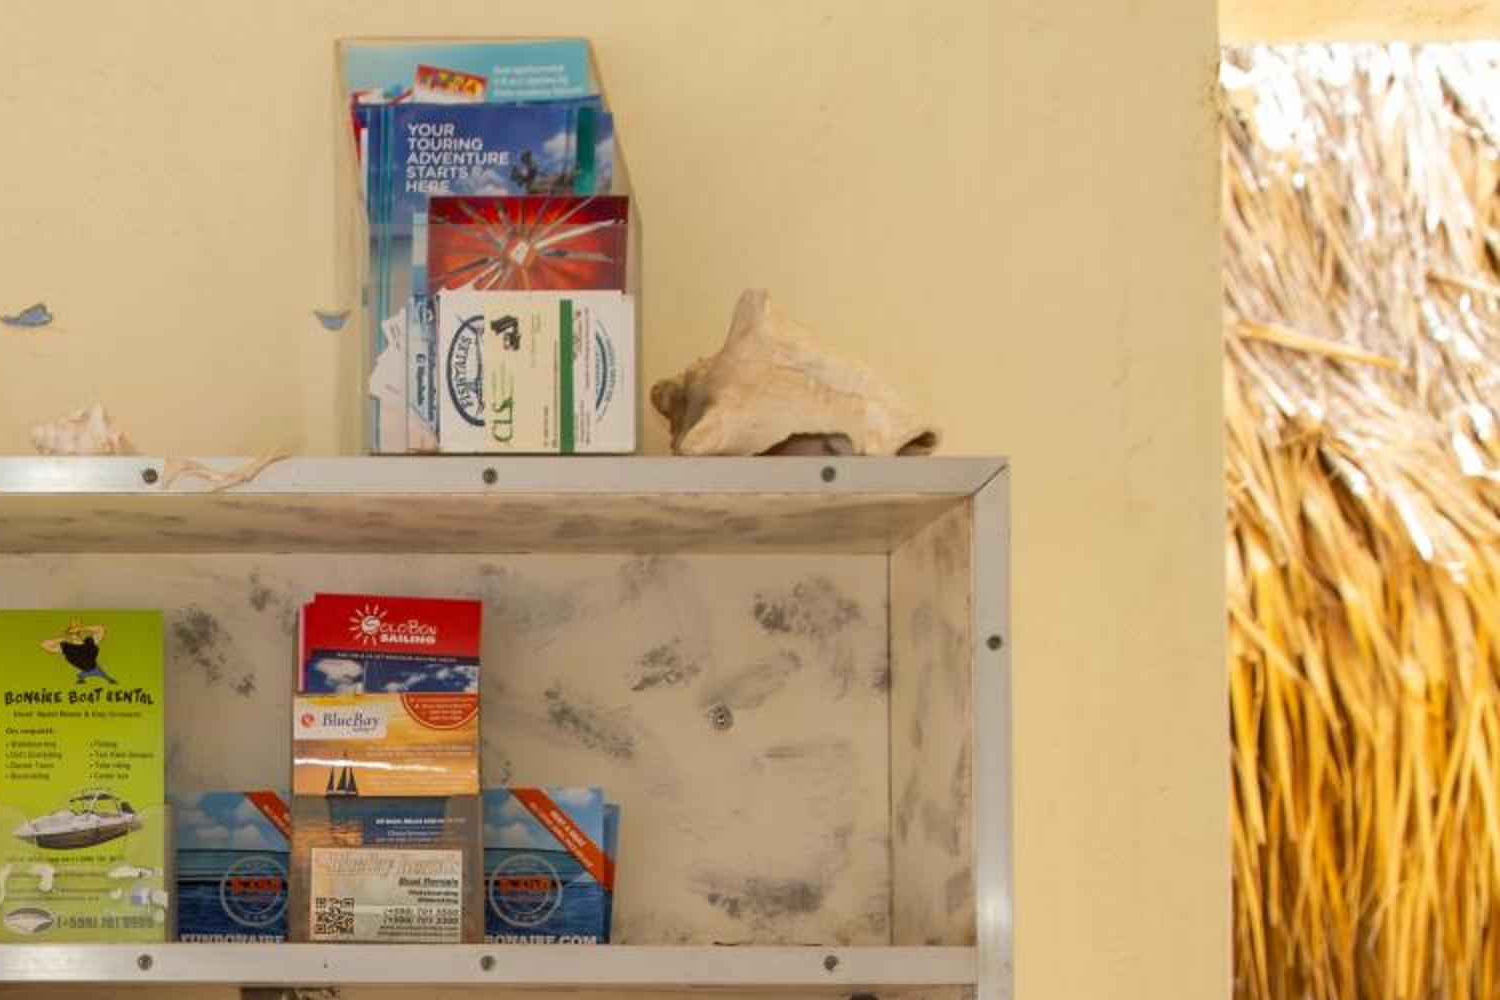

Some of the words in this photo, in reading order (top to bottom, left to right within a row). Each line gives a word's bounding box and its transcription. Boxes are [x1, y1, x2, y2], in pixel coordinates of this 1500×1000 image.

[407, 123, 455, 138] YOUR
[407, 137, 483, 151] TOURING
[406, 151, 510, 165] ADVENTURE
[406, 165, 470, 179] STARTS
[406, 179, 450, 193] HERE
[455, 334, 475, 409] FISHTALES
[380, 635, 437, 645] SAILING
[319, 711, 380, 729] BlueBay
